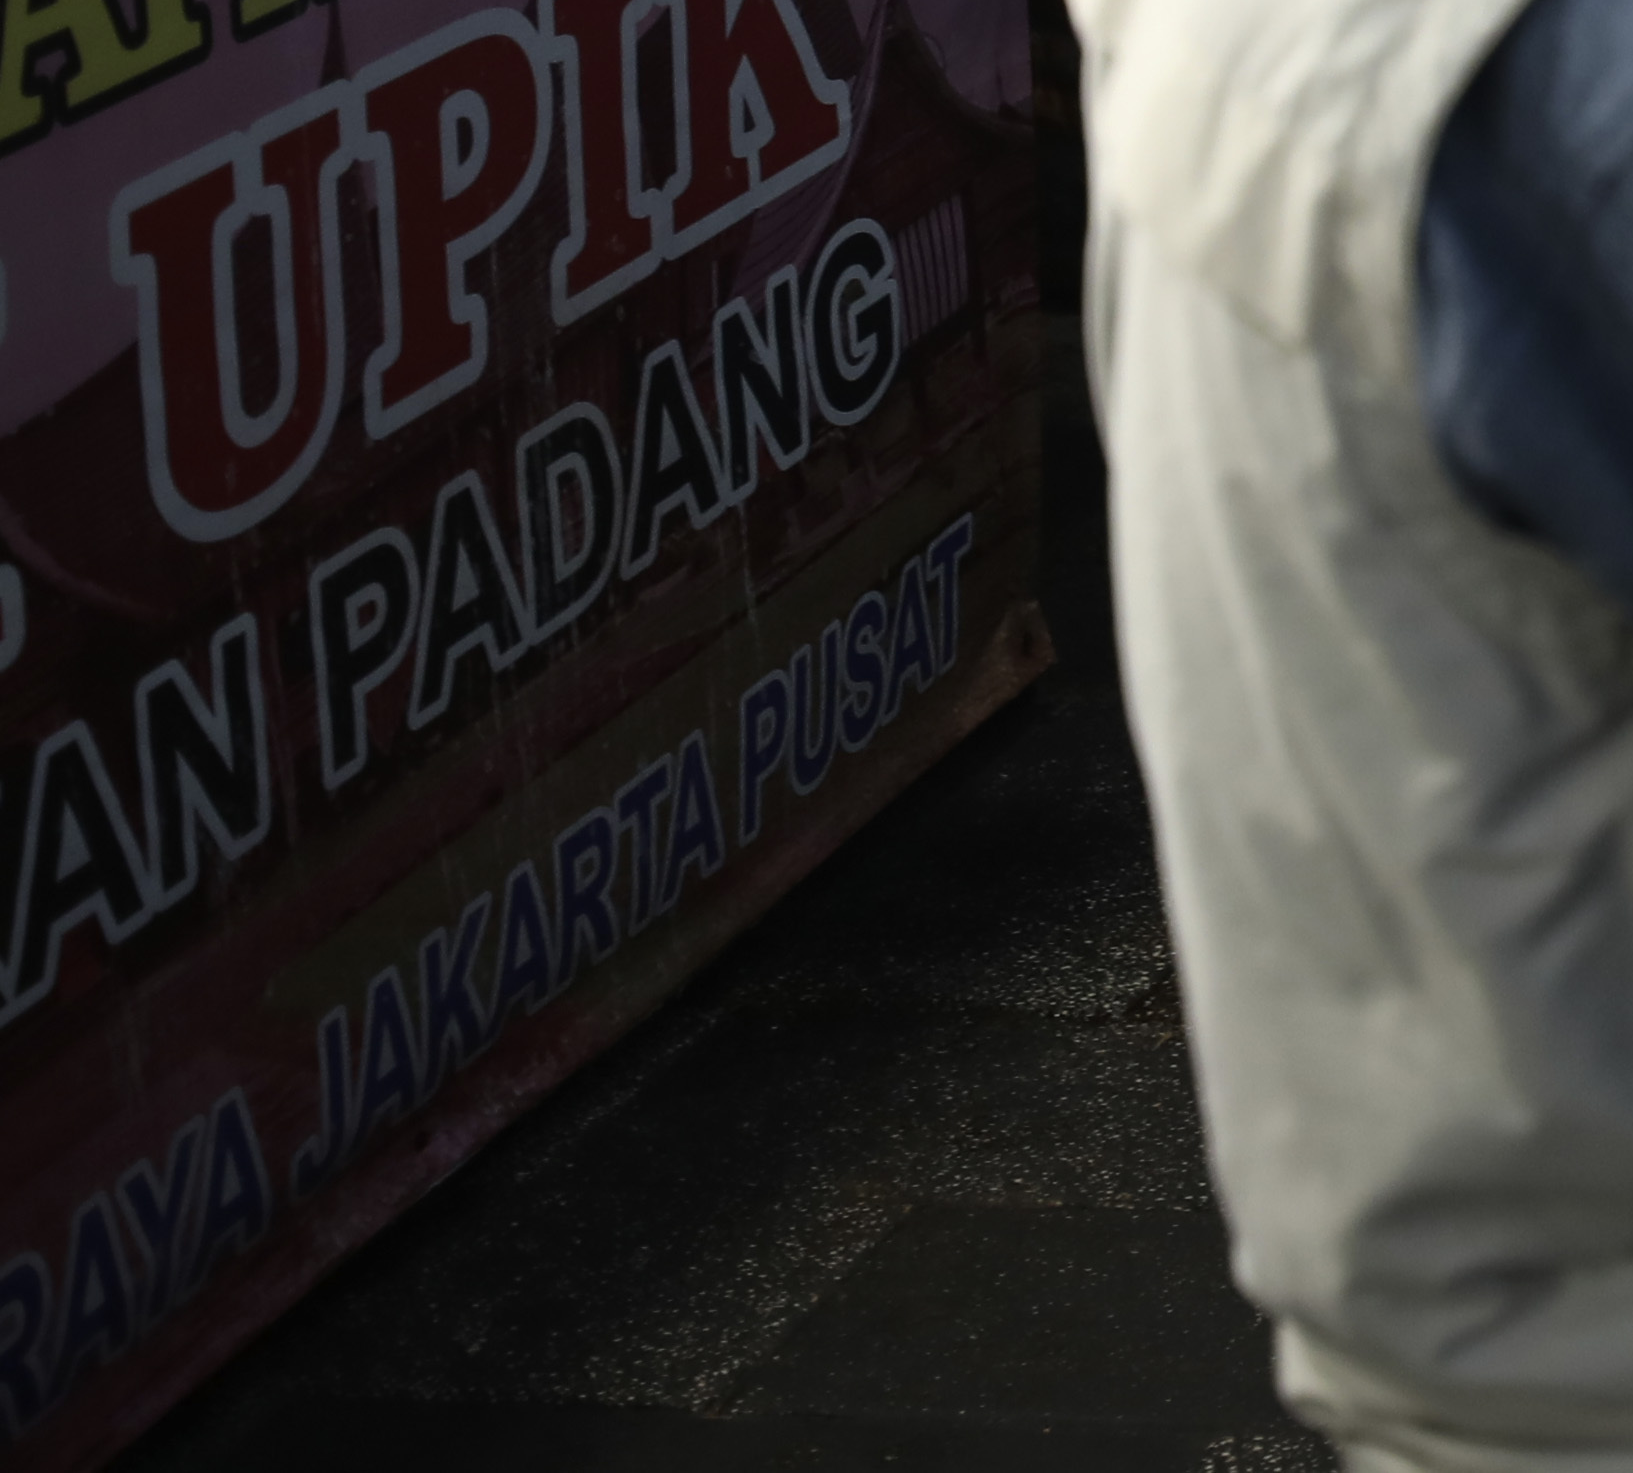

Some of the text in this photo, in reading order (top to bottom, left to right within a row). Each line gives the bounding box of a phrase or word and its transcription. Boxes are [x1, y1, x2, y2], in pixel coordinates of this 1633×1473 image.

[0, 219, 901, 1028] AN PADANG
[0, 513, 973, 1441] RAYA JAKARTA PUSAT
